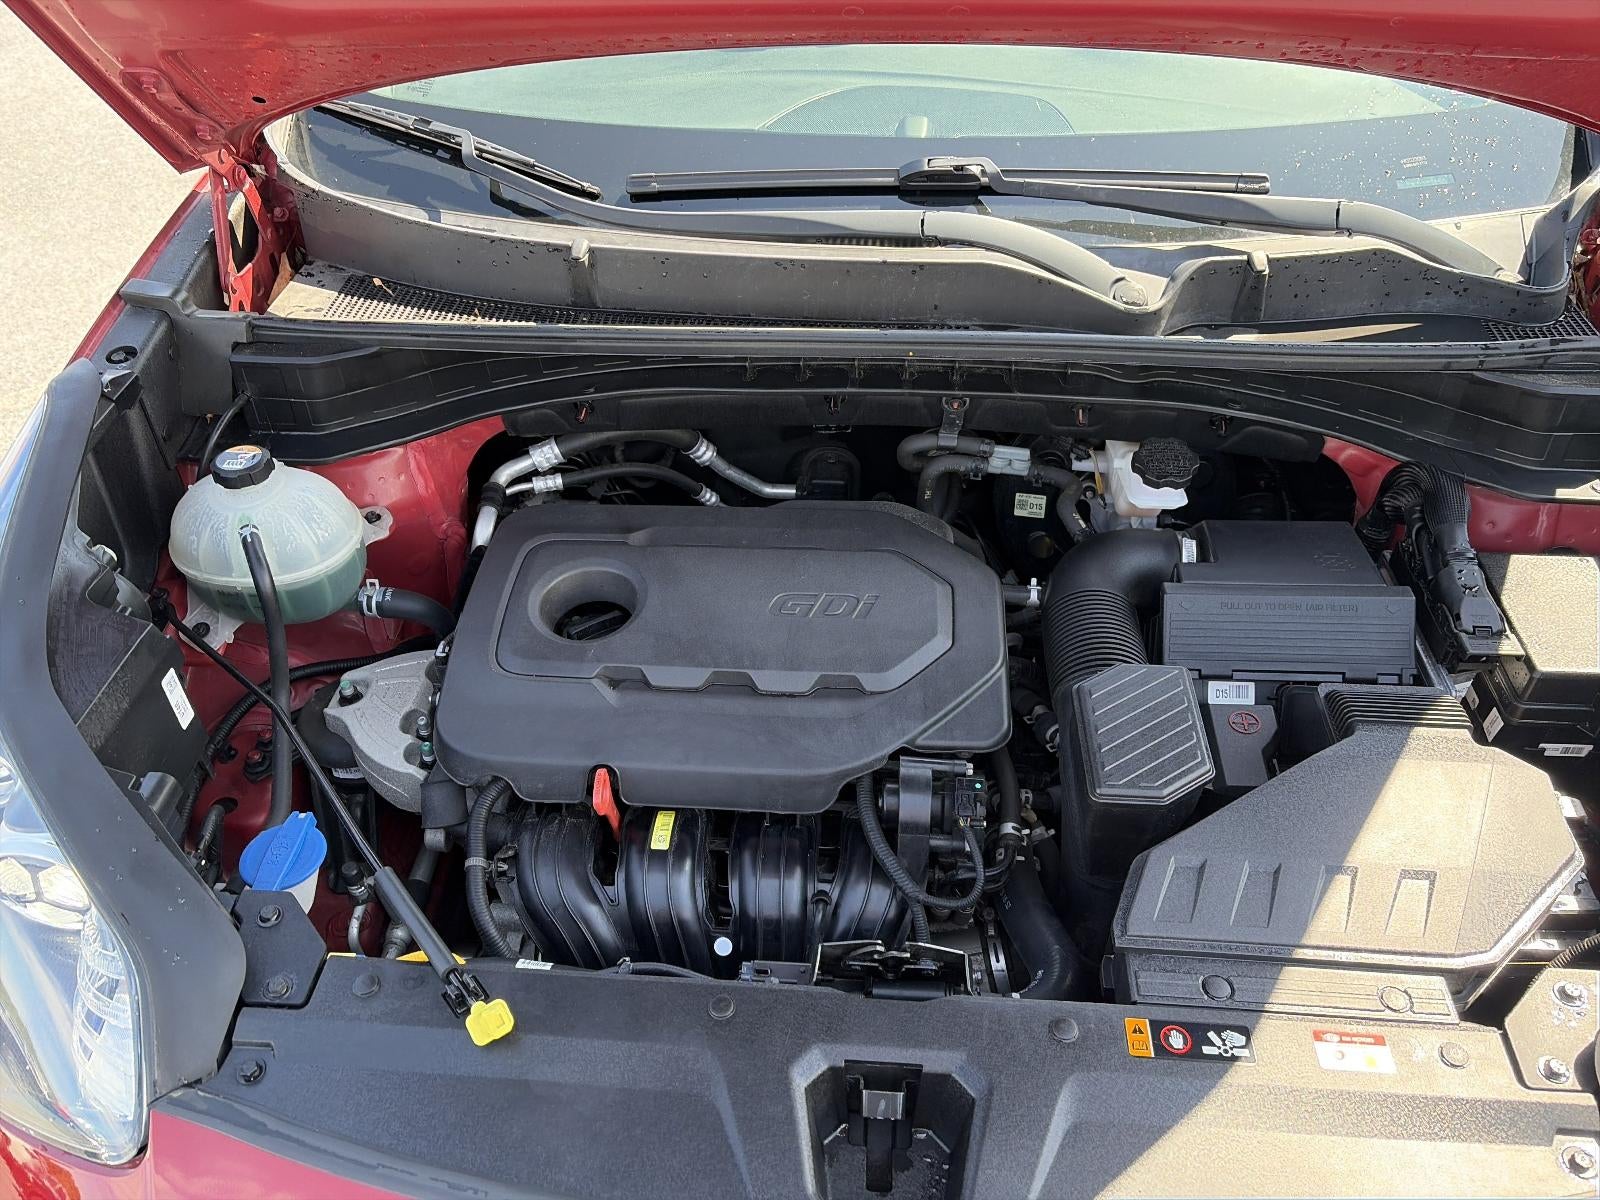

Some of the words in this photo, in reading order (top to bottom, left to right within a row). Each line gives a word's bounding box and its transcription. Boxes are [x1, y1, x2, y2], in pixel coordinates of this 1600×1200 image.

[1220, 602, 1243, 610] PULL
[1245, 602, 1261, 610] OUT
[1277, 602, 1301, 611] OPEN
[1215, 688, 1229, 699] D15
